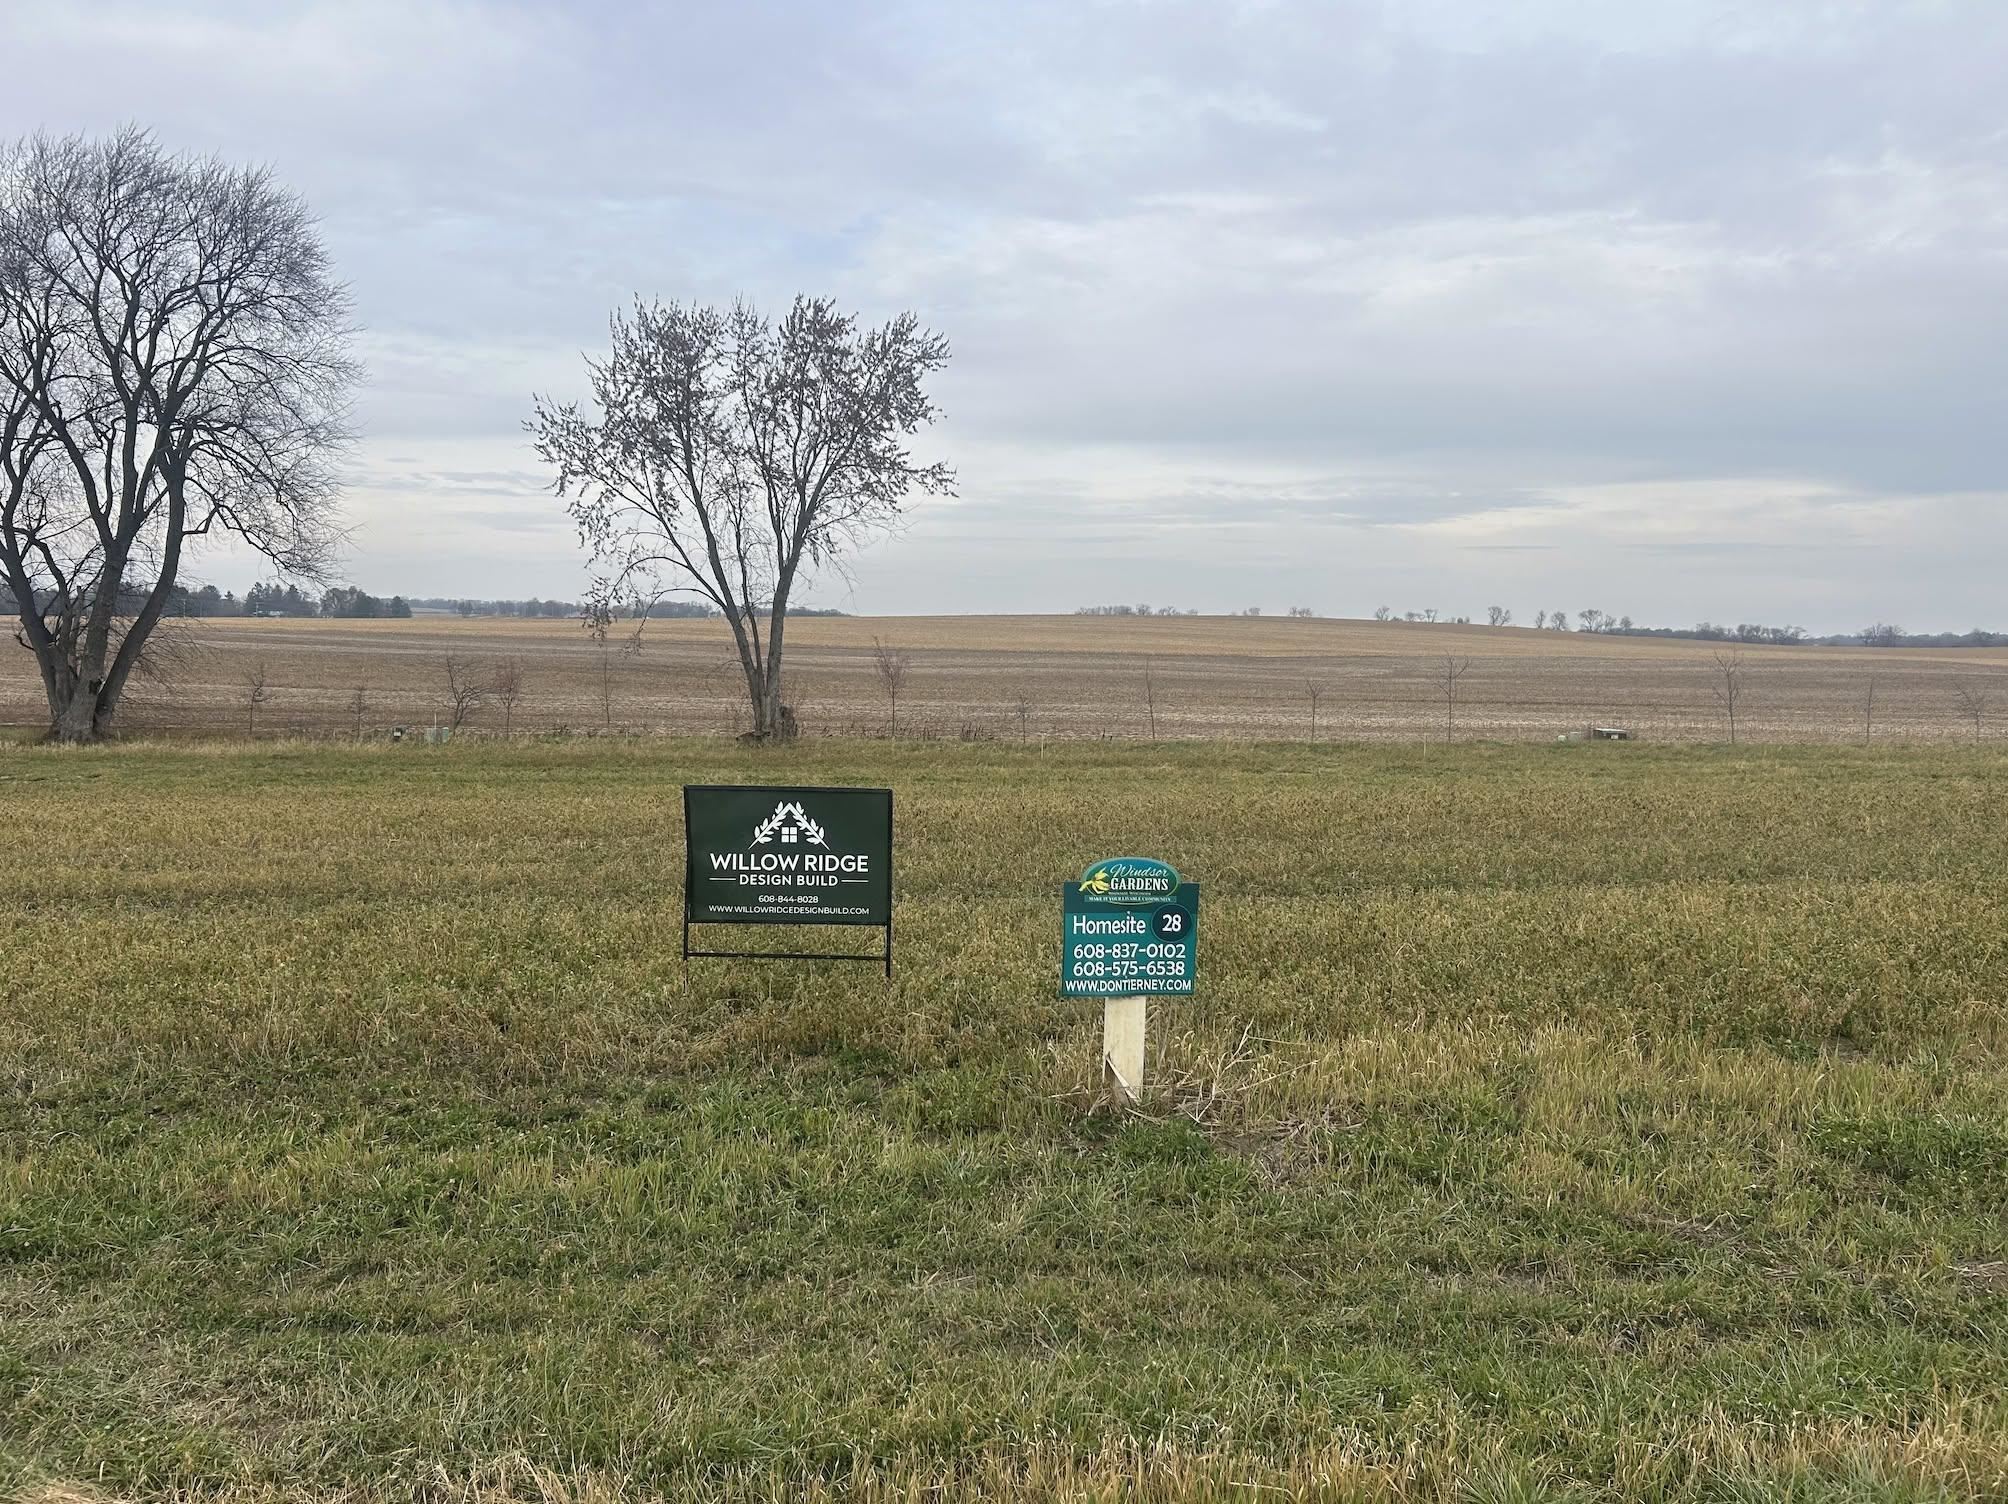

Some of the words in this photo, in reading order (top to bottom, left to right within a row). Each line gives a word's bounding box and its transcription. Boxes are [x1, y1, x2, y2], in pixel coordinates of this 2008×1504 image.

[709, 852, 800, 872] WILLOW
[804, 854, 869, 873] RIDGE
[1110, 863, 1168, 878] Windsor
[739, 874, 792, 886] DESIGN
[796, 875, 838, 887] BUILD
[1110, 877, 1169, 891] GARDENS
[758, 894, 819, 904] 608-844-8028
[708, 904, 870, 915] WWW.WILLOWRIDGEDESIGNBUILD.COM
[1073, 914, 1146, 934] Homesite
[1162, 913, 1182, 932] 28
[1073, 943, 1186, 959] 608-837-0102
[1073, 961, 1185, 977] 608-575-6538
[1065, 979, 1192, 992] WWW.DONTIERNEY.COM
